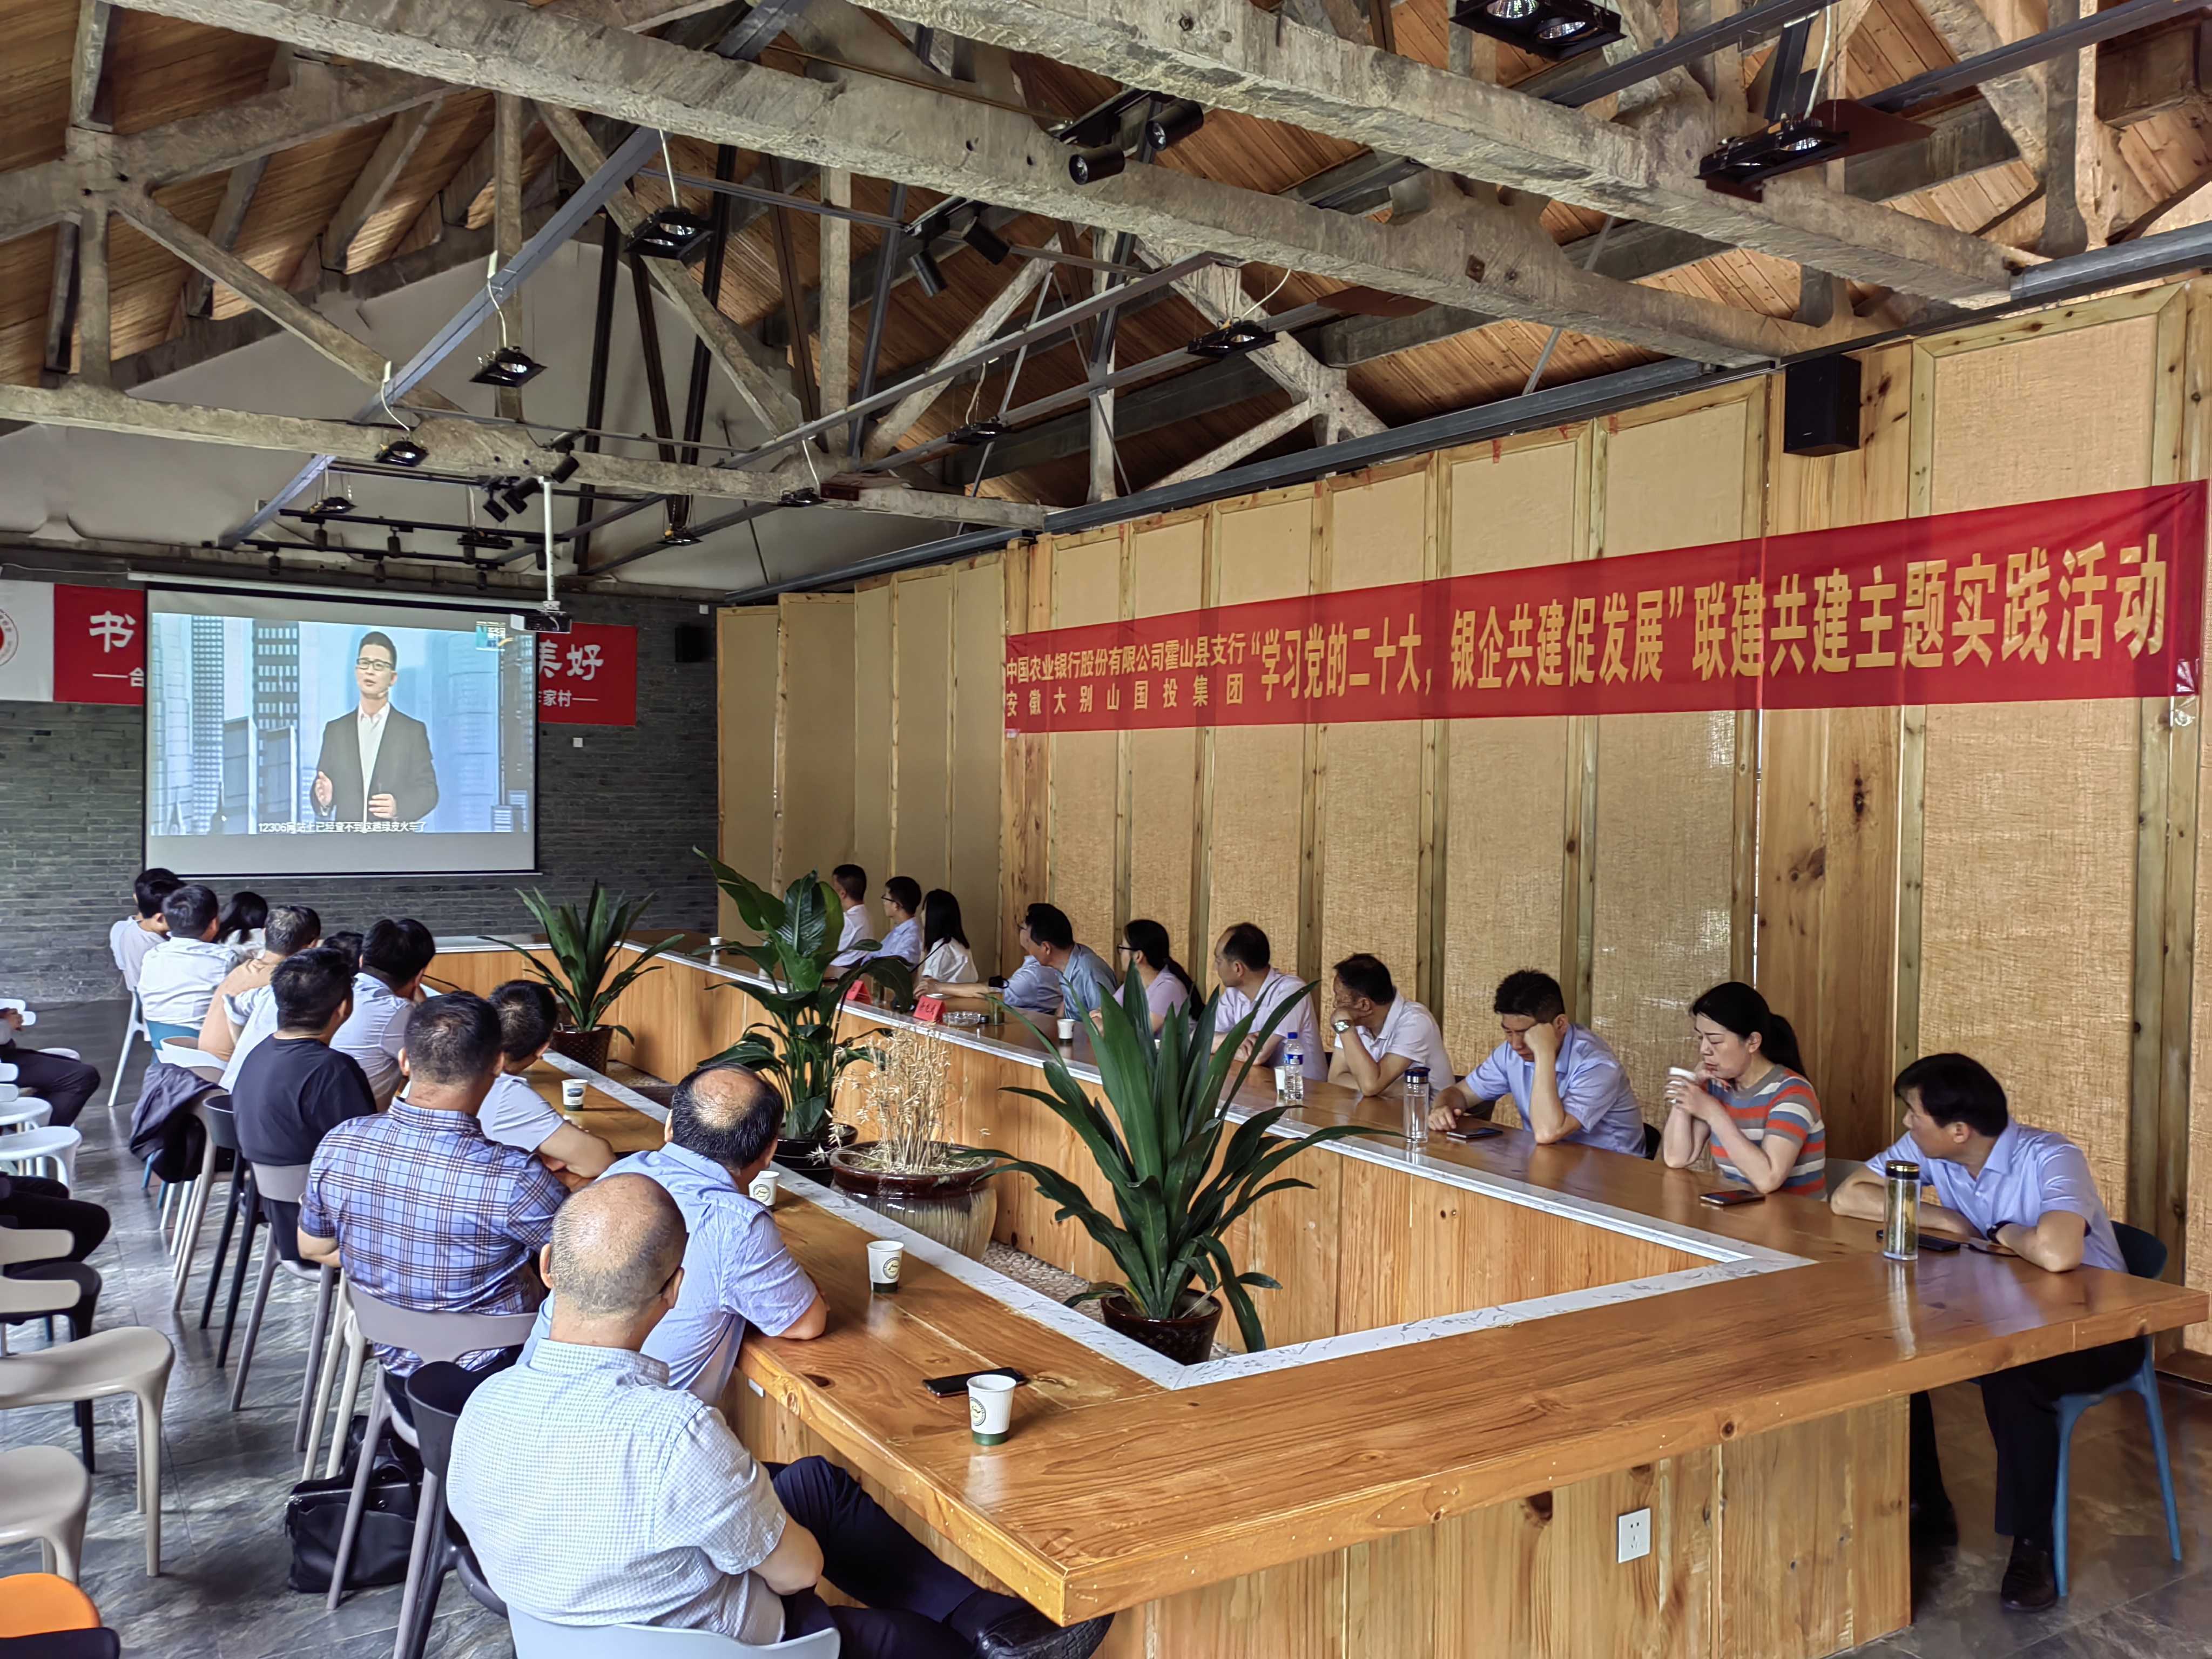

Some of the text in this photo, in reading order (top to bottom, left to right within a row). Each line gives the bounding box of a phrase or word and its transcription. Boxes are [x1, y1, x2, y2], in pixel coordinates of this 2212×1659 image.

[89, 610, 136, 653] 书
[1006, 632, 1246, 685] 中国农业银行股份有限公司霍山县支行
[1006, 673, 1244, 717] 安徽大别山国投集团
